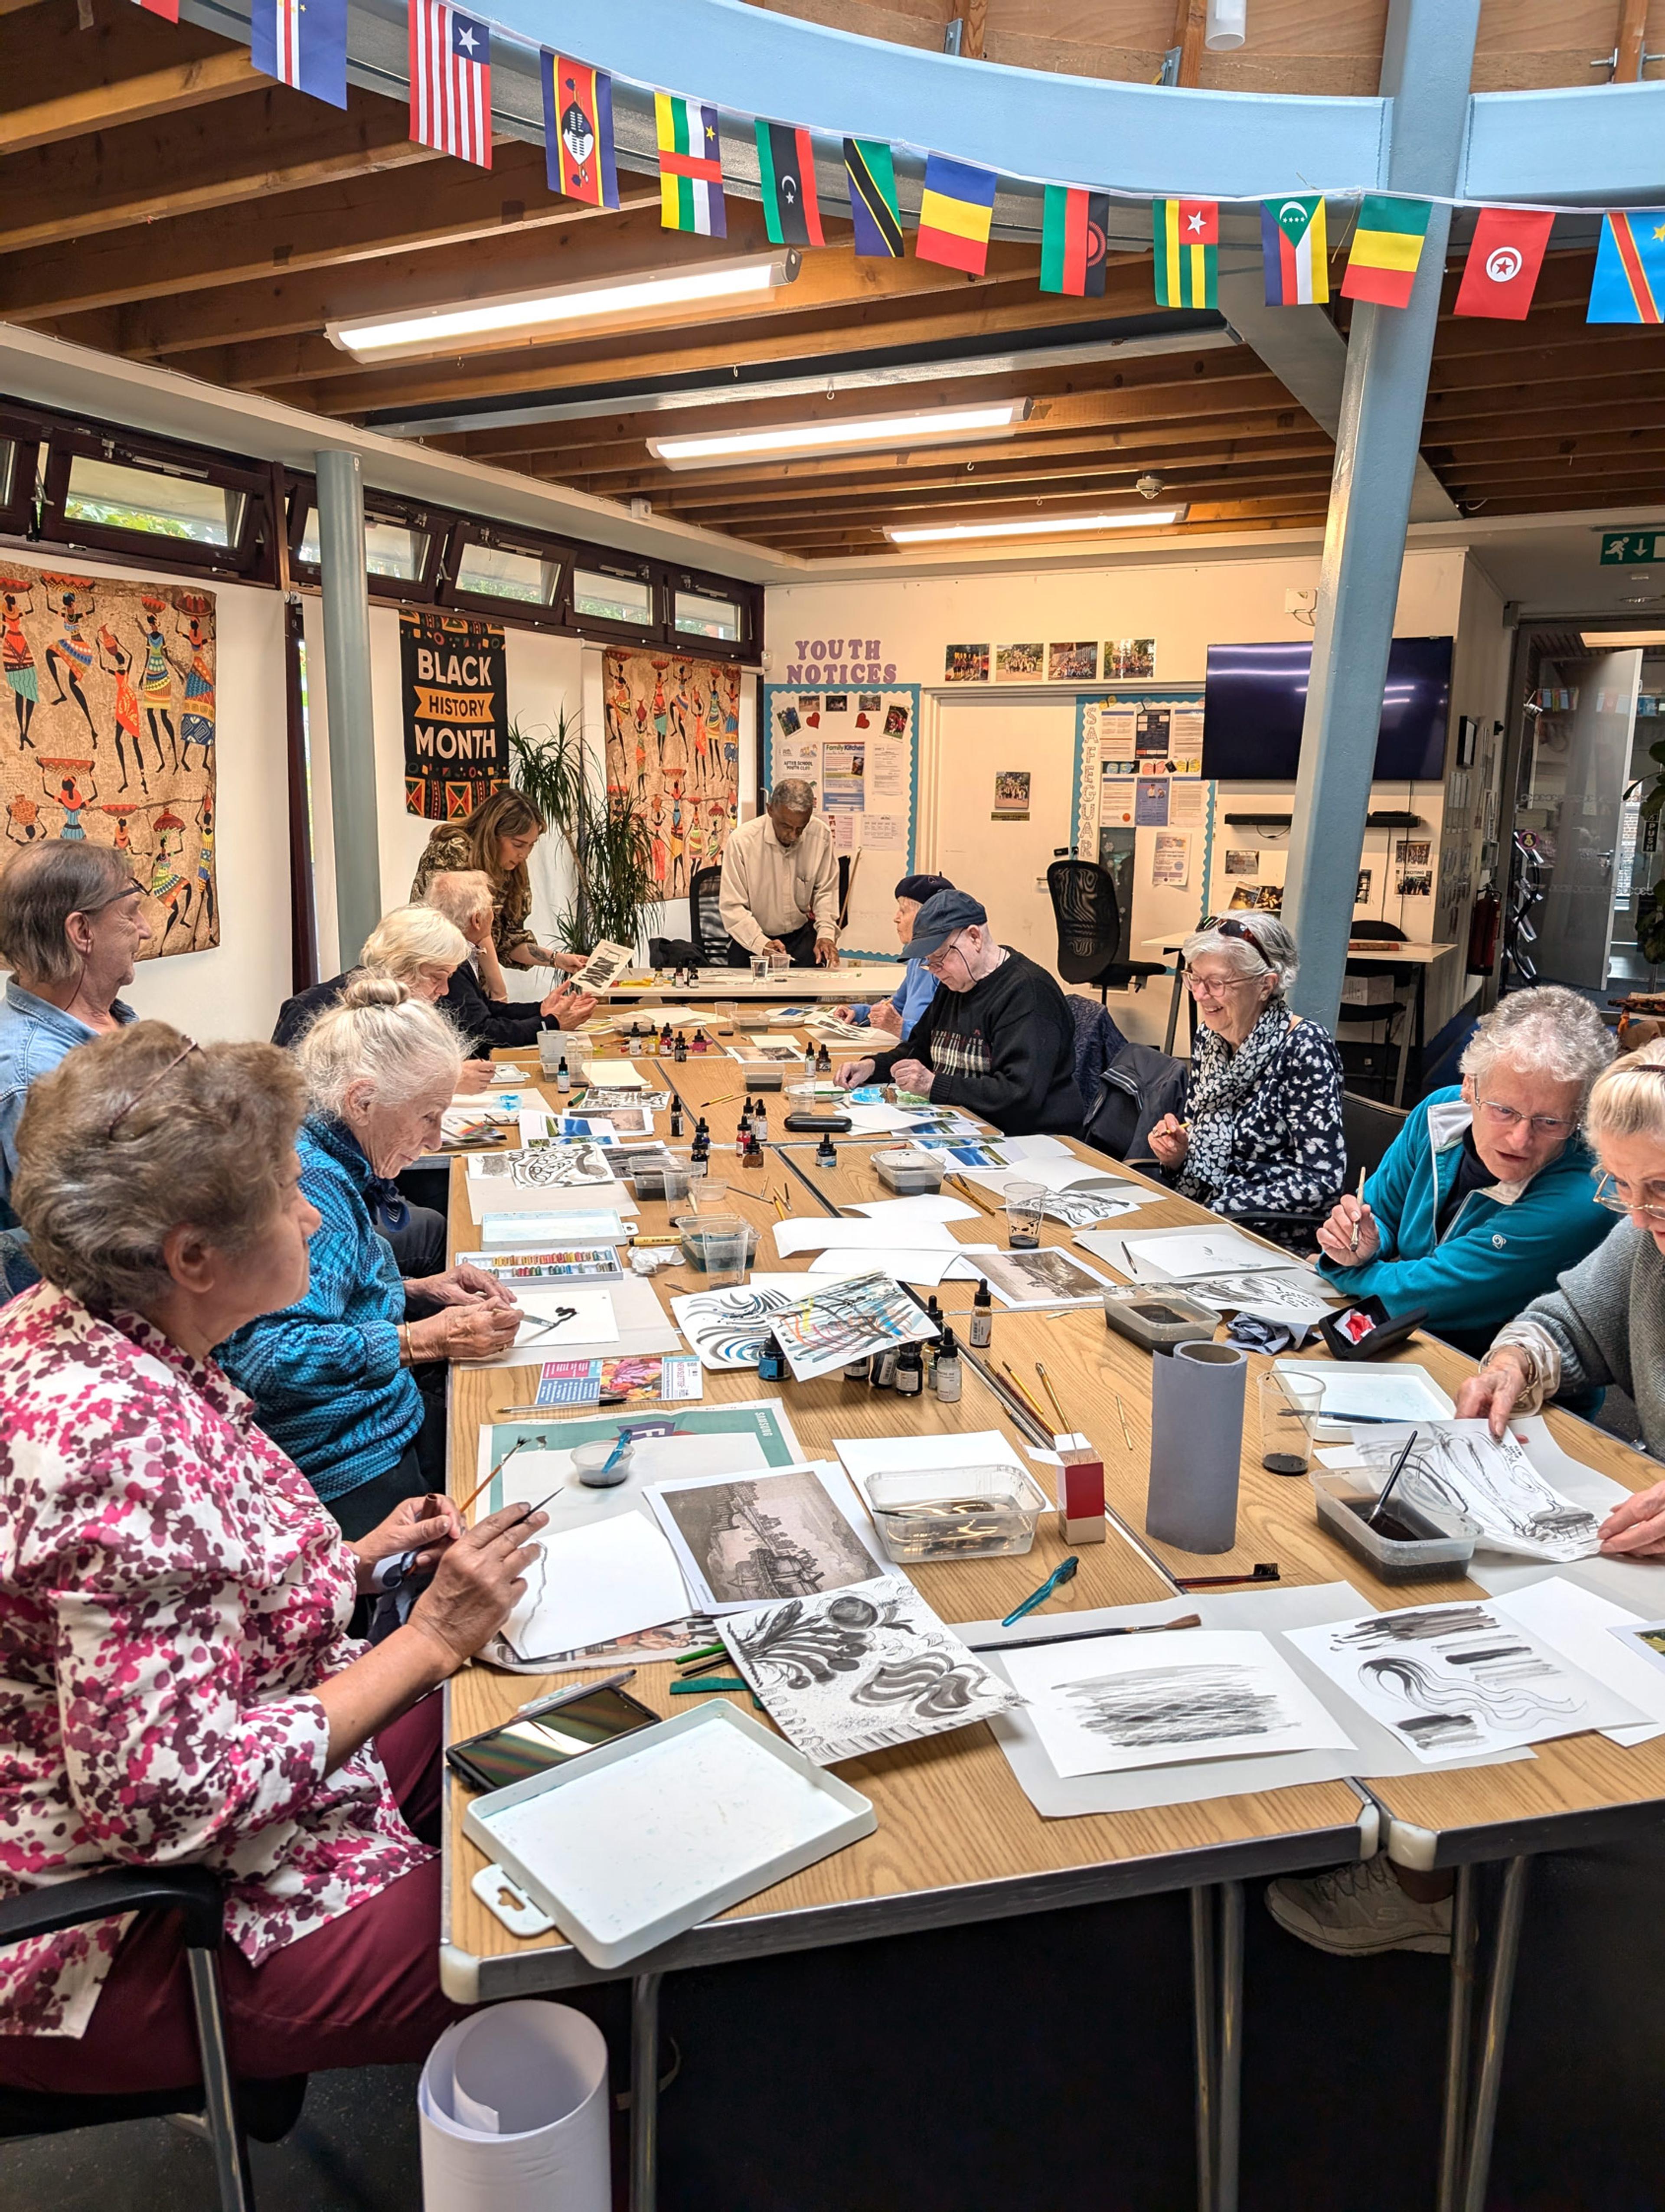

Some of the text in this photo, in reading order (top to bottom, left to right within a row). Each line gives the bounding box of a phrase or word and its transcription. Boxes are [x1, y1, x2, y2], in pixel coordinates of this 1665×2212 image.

[795, 640, 881, 660] YOUTH
[418, 648, 492, 686] BLACK
[787, 663, 896, 684] NOTICES
[429, 695, 484, 716] HISTORY
[415, 724, 496, 759] MONTH
[1646, 823, 1656, 851] PUSH
[755, 1411, 773, 1437] SAMSUNG
